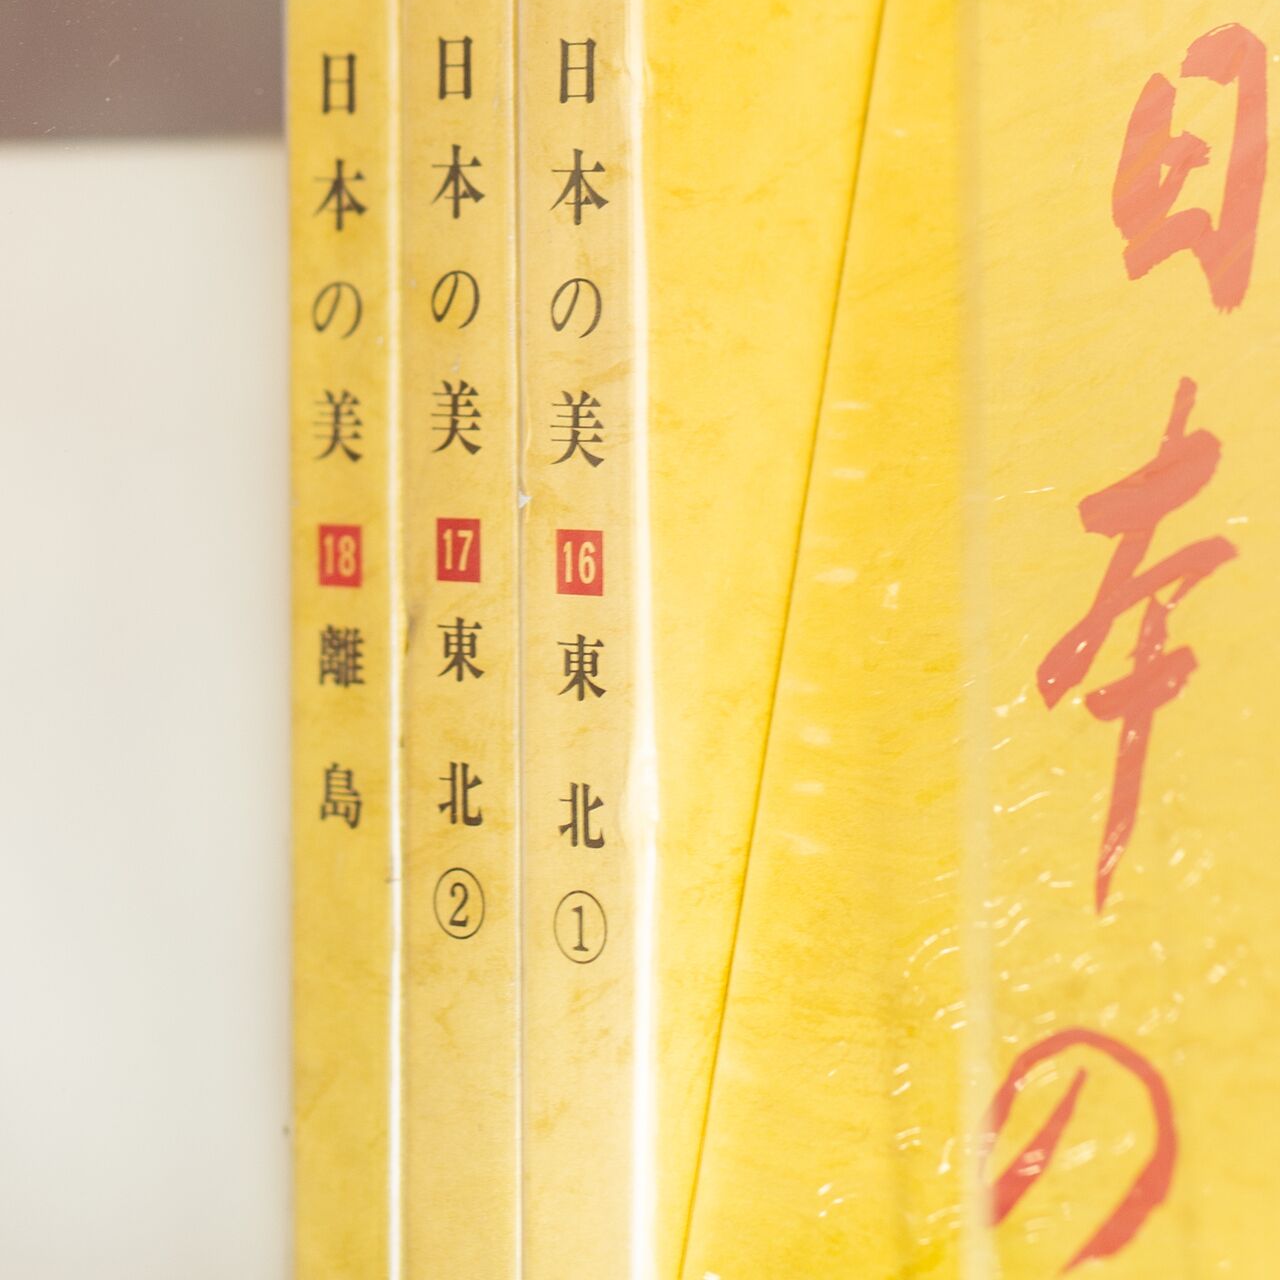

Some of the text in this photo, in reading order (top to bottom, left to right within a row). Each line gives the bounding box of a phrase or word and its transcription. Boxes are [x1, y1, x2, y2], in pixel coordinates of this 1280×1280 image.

[313, 52, 368, 463] 日本の美
[431, 36, 485, 455] 日本の美
[549, 37, 609, 468] 日本の美
[319, 624, 365, 830] 離島
[978, 21, 1268, 1277] 日本の
